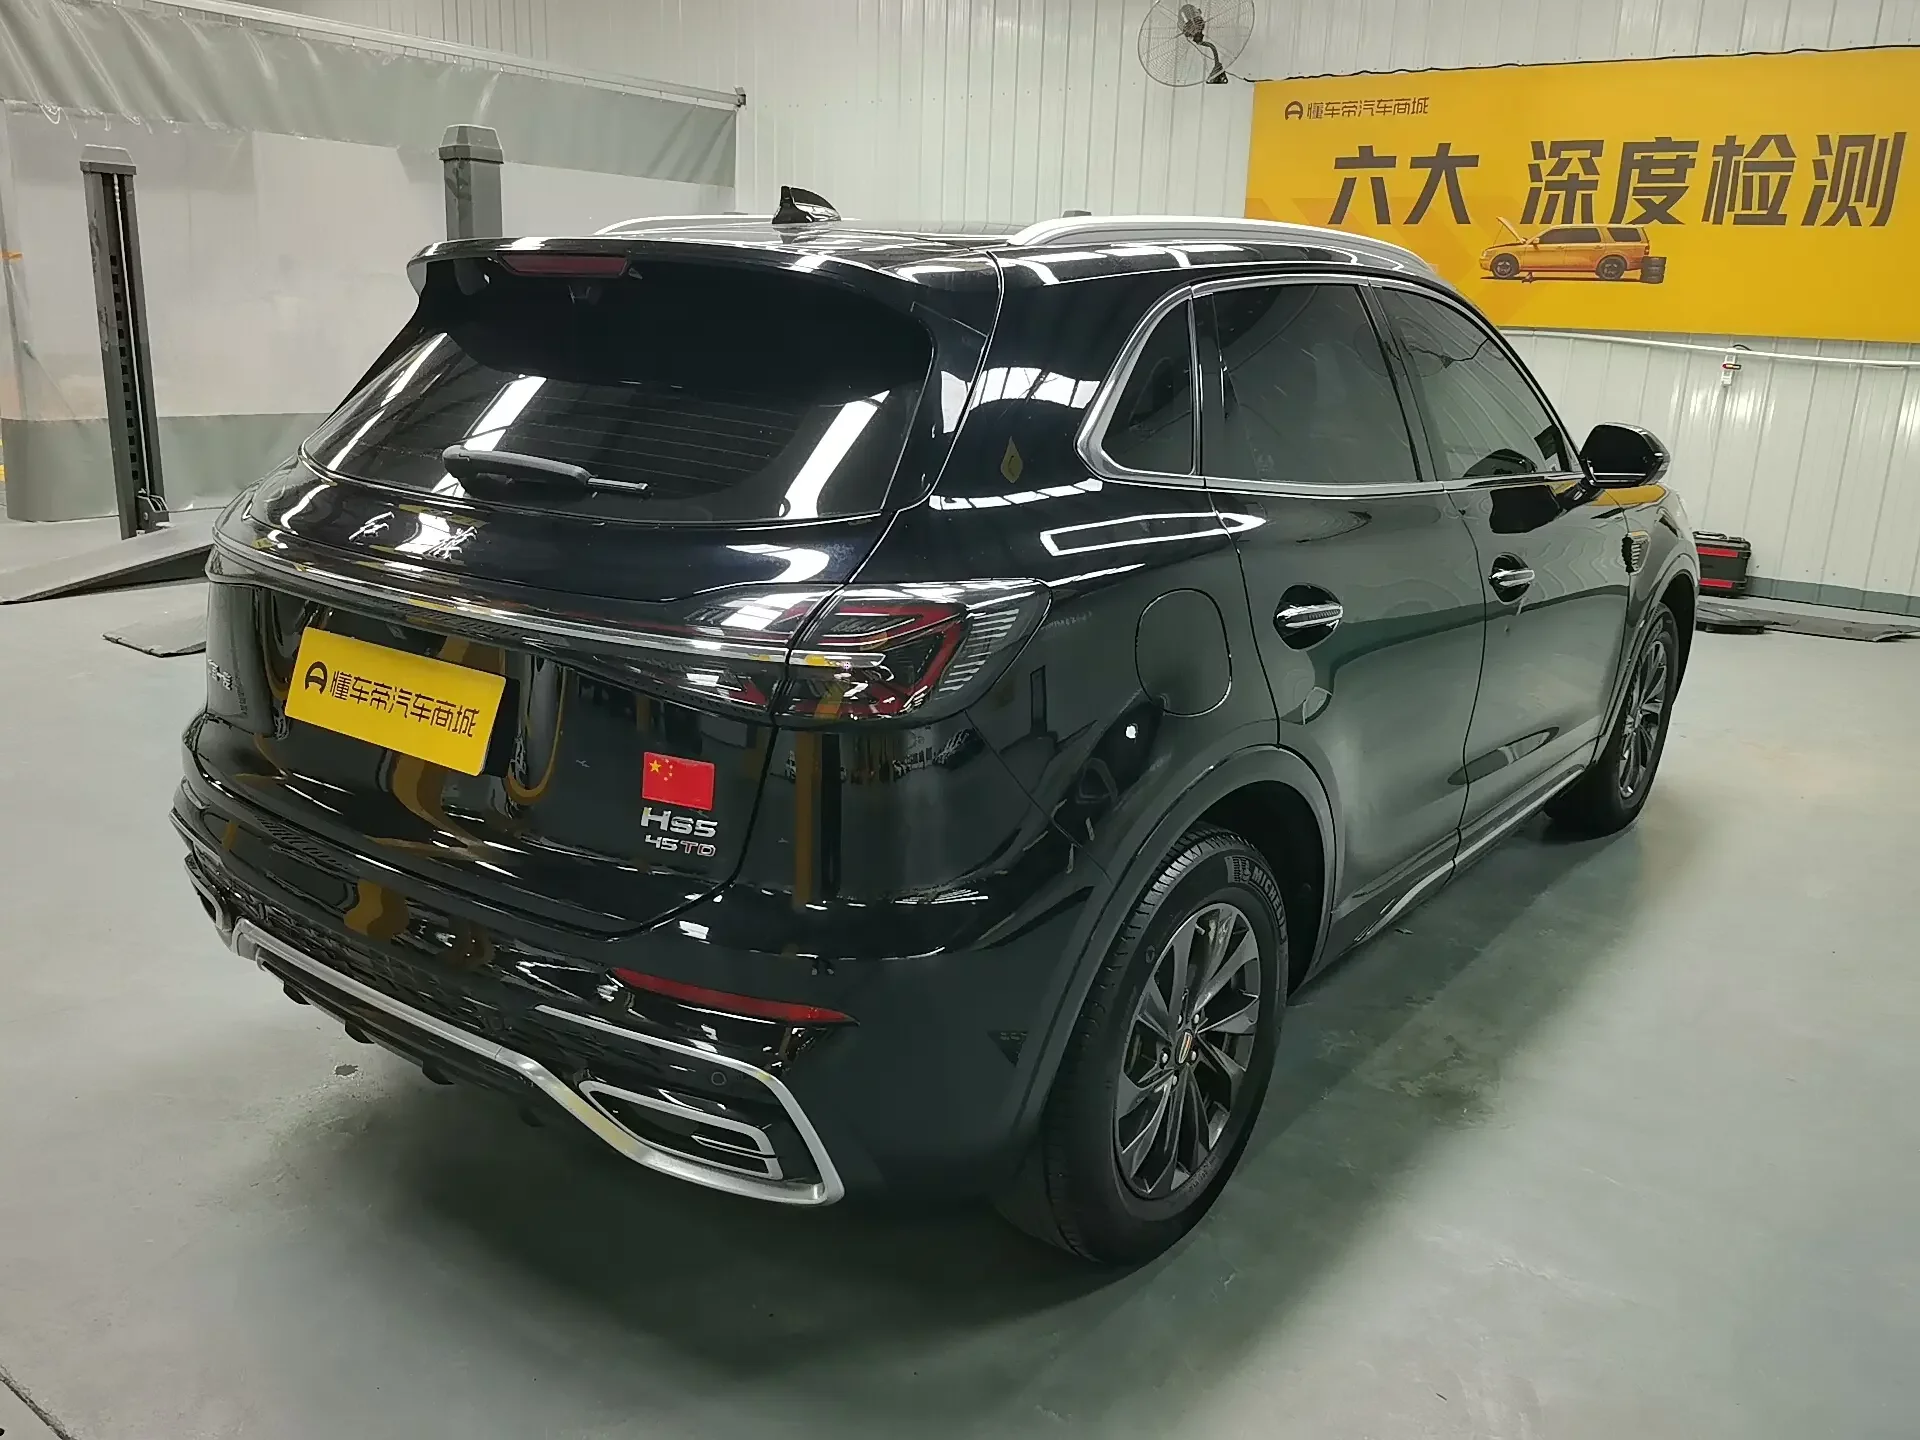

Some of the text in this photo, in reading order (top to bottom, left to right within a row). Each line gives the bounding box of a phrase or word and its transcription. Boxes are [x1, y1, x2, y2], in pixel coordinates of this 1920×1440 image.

[1306, 97, 1430, 120] 懂车帝汽车商城
[1327, 131, 1907, 227] 六大 深度检测
[330, 670, 480, 738] 懂车帝汽车商城
[640, 806, 718, 838] HS5
[644, 834, 716, 857] 45TD
